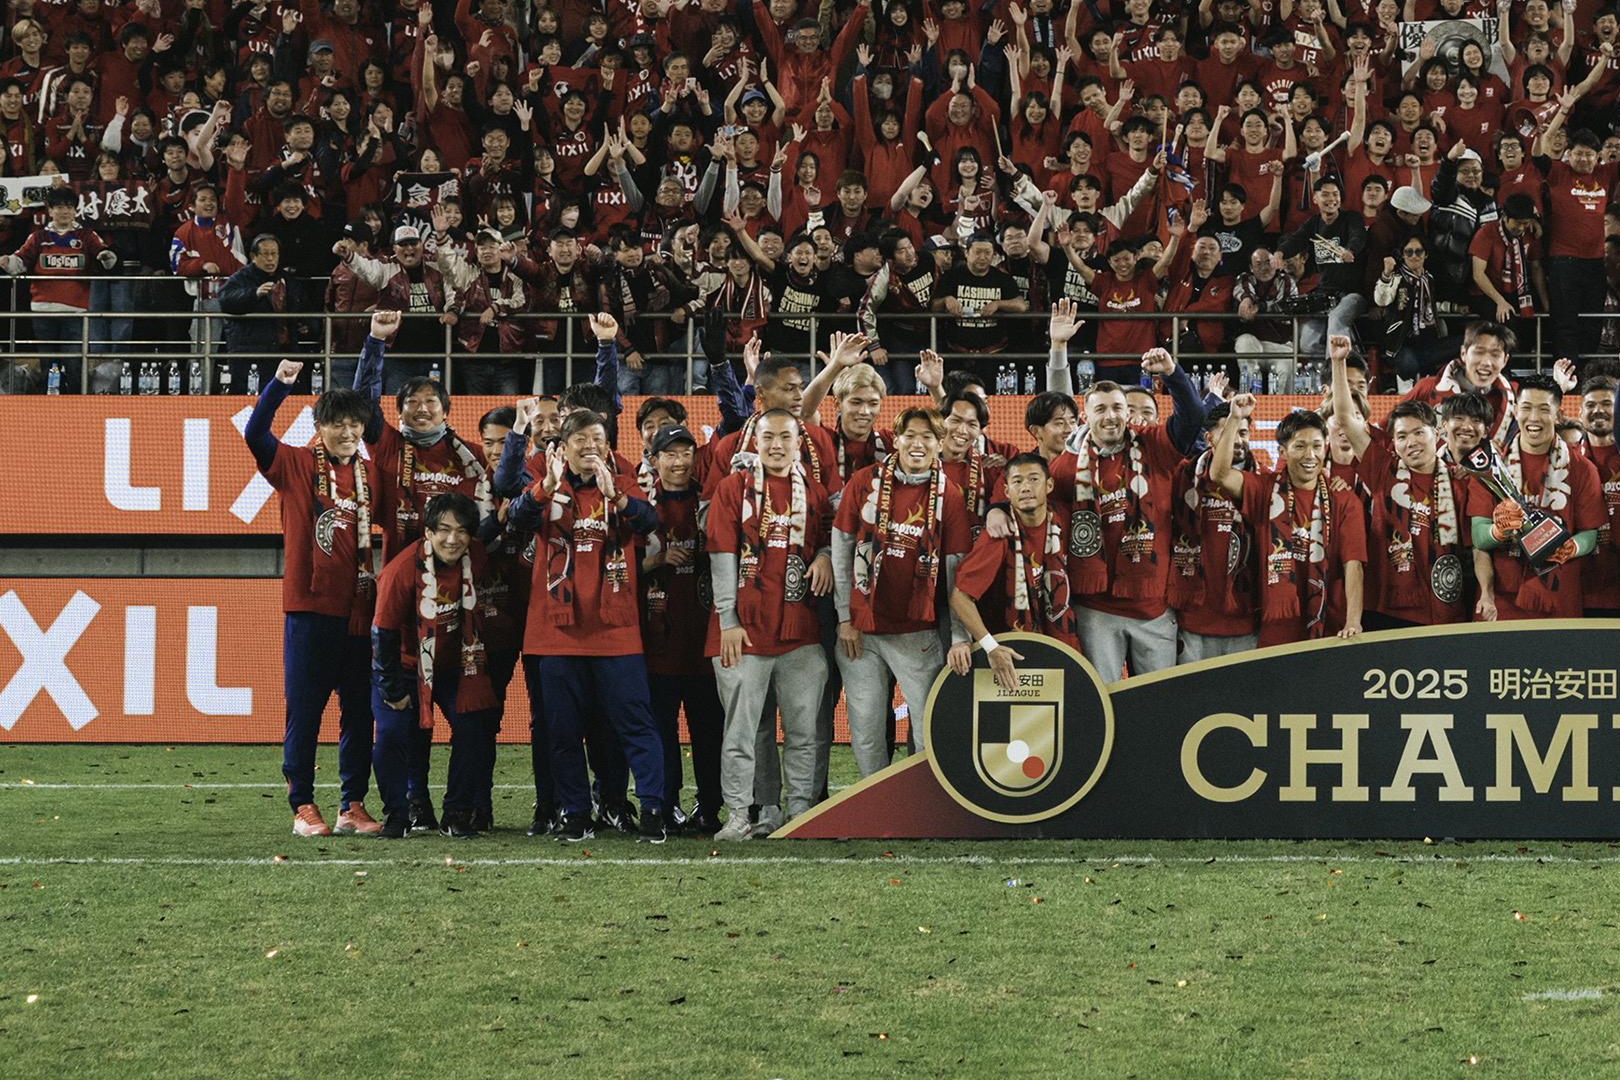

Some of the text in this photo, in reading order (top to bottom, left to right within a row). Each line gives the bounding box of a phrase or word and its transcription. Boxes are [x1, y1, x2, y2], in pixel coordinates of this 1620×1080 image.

[556, 143, 590, 157] LIXIL
[597, 191, 628, 206] LIXI
[46, 255, 78, 268] TOSTEM
[957, 284, 1001, 298] KASHIMA
[967, 495, 976, 513] 2025
[1108, 514, 1126, 523] 2025
[879, 518, 888, 534] 2025
[768, 540, 787, 549] 2025
[887, 548, 904, 557] 2025
[1363, 668, 1468, 699] 2025
[1489, 667, 1617, 700] 明治安田
